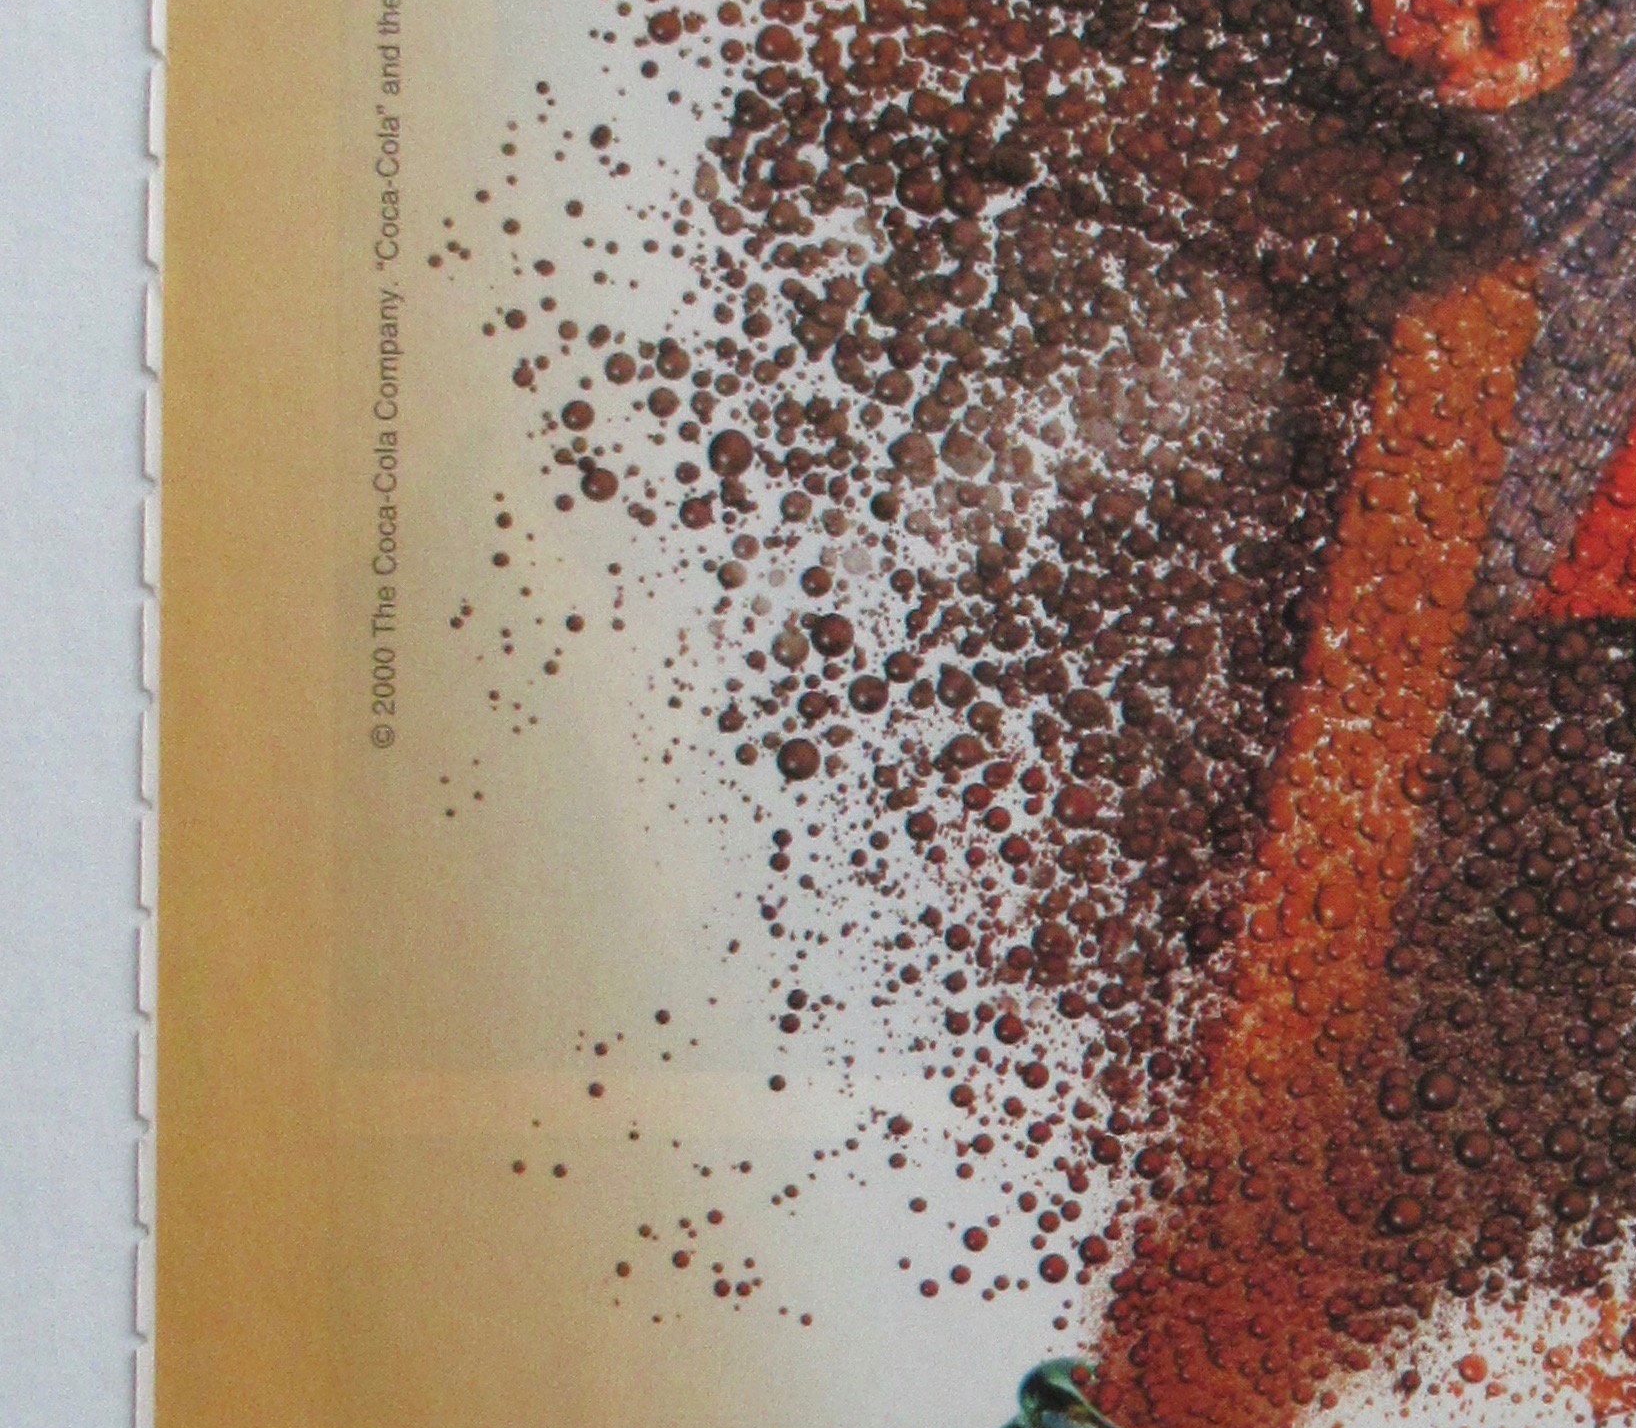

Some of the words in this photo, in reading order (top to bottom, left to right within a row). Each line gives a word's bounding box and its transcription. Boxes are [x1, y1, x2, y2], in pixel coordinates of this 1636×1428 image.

[376, 43, 402, 97] and
[372, 281, 406, 422] Company.
[370, 430, 399, 577] Coca-Cola
[370, 585, 397, 639] The
[370, 646, 397, 717] 2000
